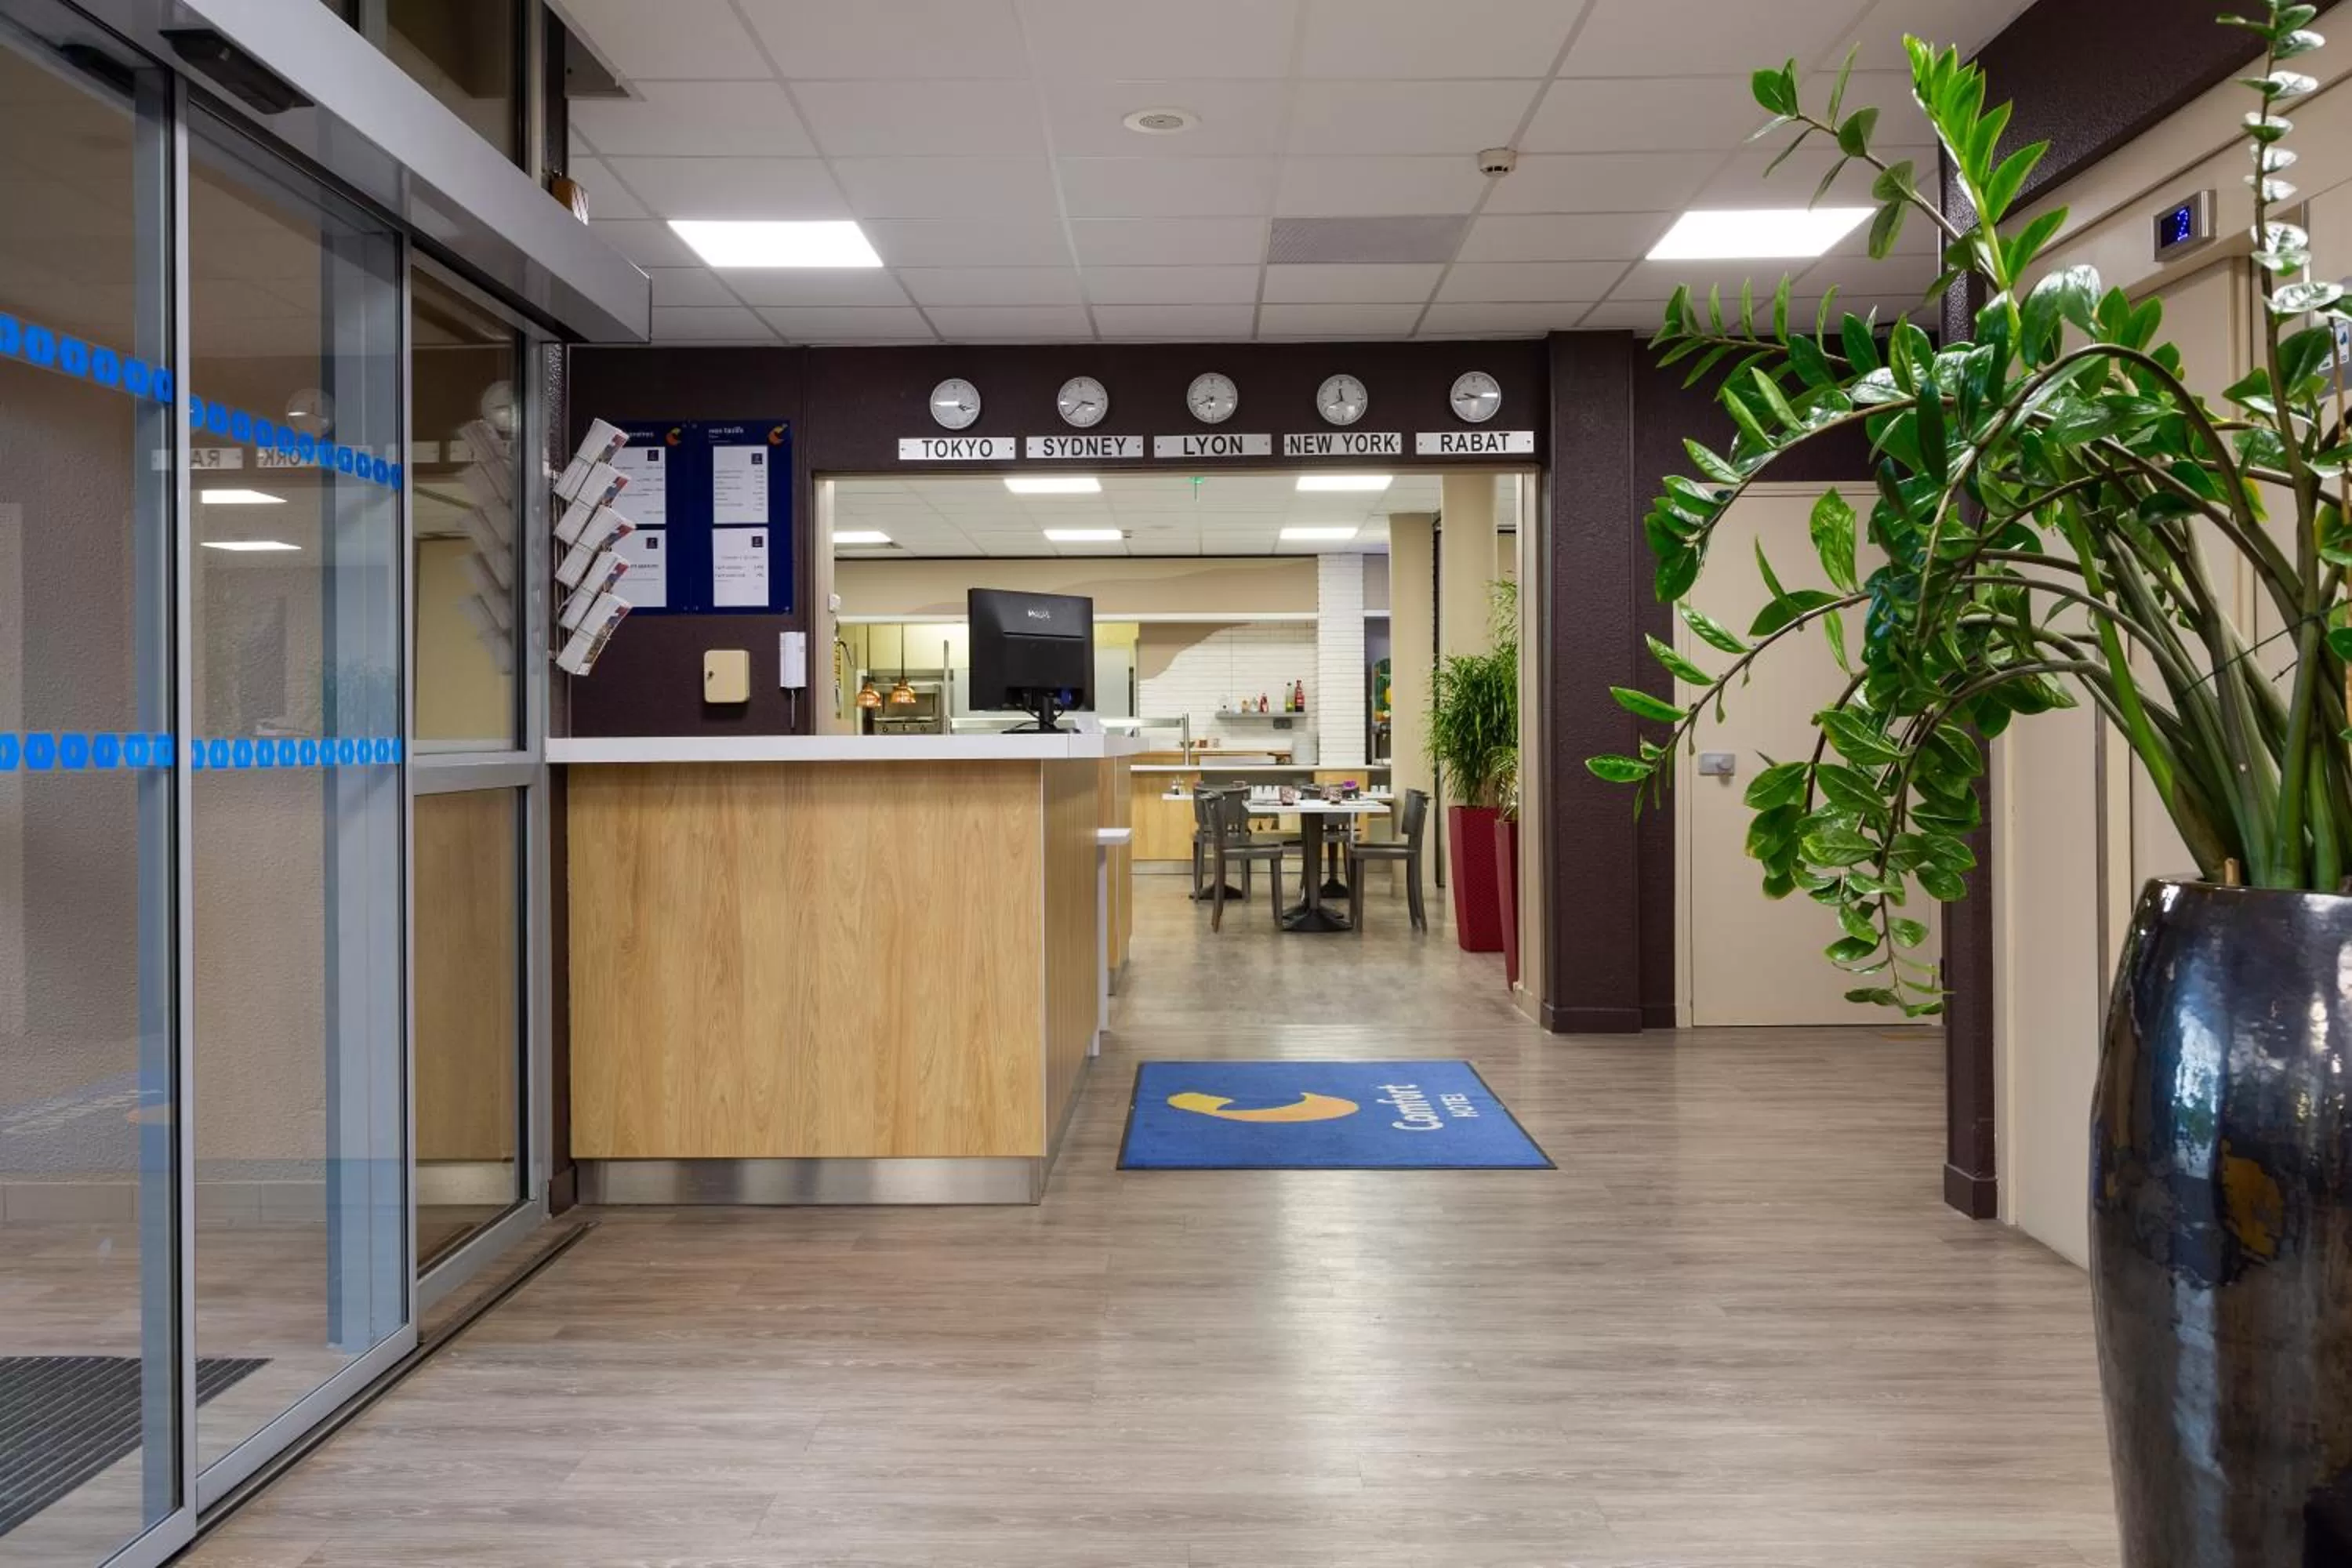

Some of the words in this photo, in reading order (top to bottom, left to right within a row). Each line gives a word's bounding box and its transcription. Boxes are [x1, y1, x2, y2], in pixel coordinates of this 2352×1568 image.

[921, 439, 993, 458] TOKYO
[1043, 437, 1127, 457] SYDNEY
[1183, 436, 1243, 455] LYON
[1290, 436, 1332, 453] NEW
[1342, 434, 1396, 452] YORK
[1440, 433, 1510, 452] RABAT
[1377, 1084, 1443, 1130] Comfort
[1439, 1094, 1480, 1117] HOTEL
